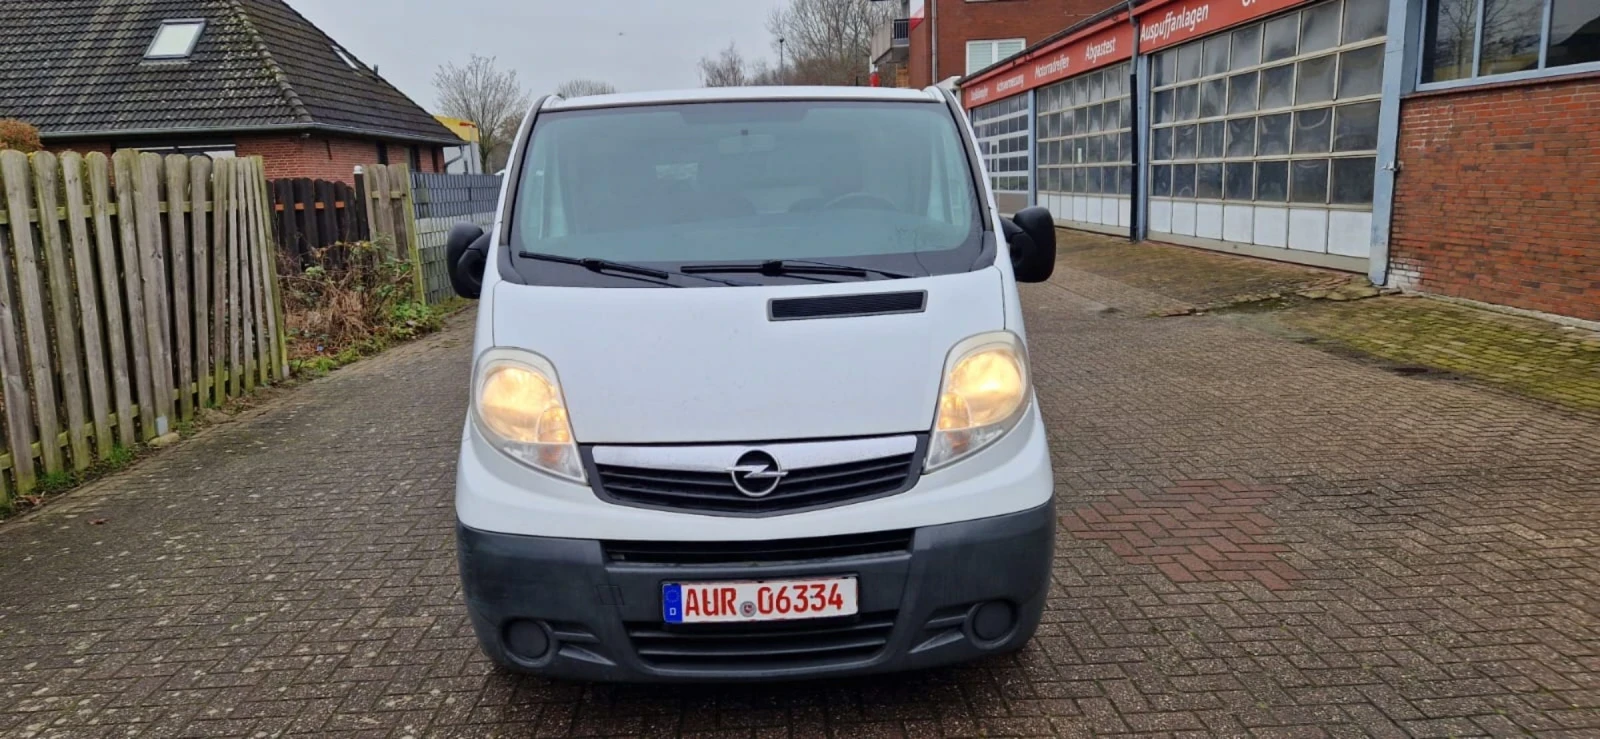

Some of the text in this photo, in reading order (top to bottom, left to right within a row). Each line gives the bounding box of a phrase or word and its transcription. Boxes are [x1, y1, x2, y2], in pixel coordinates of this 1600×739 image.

[1140, 4, 1208, 44] Auspuffanlagen
[1035, 54, 1069, 79] Motorradreifen
[1085, 36, 1116, 64] Abgastest
[669, 607, 677, 616] D
[685, 583, 843, 617] AUR 06334
